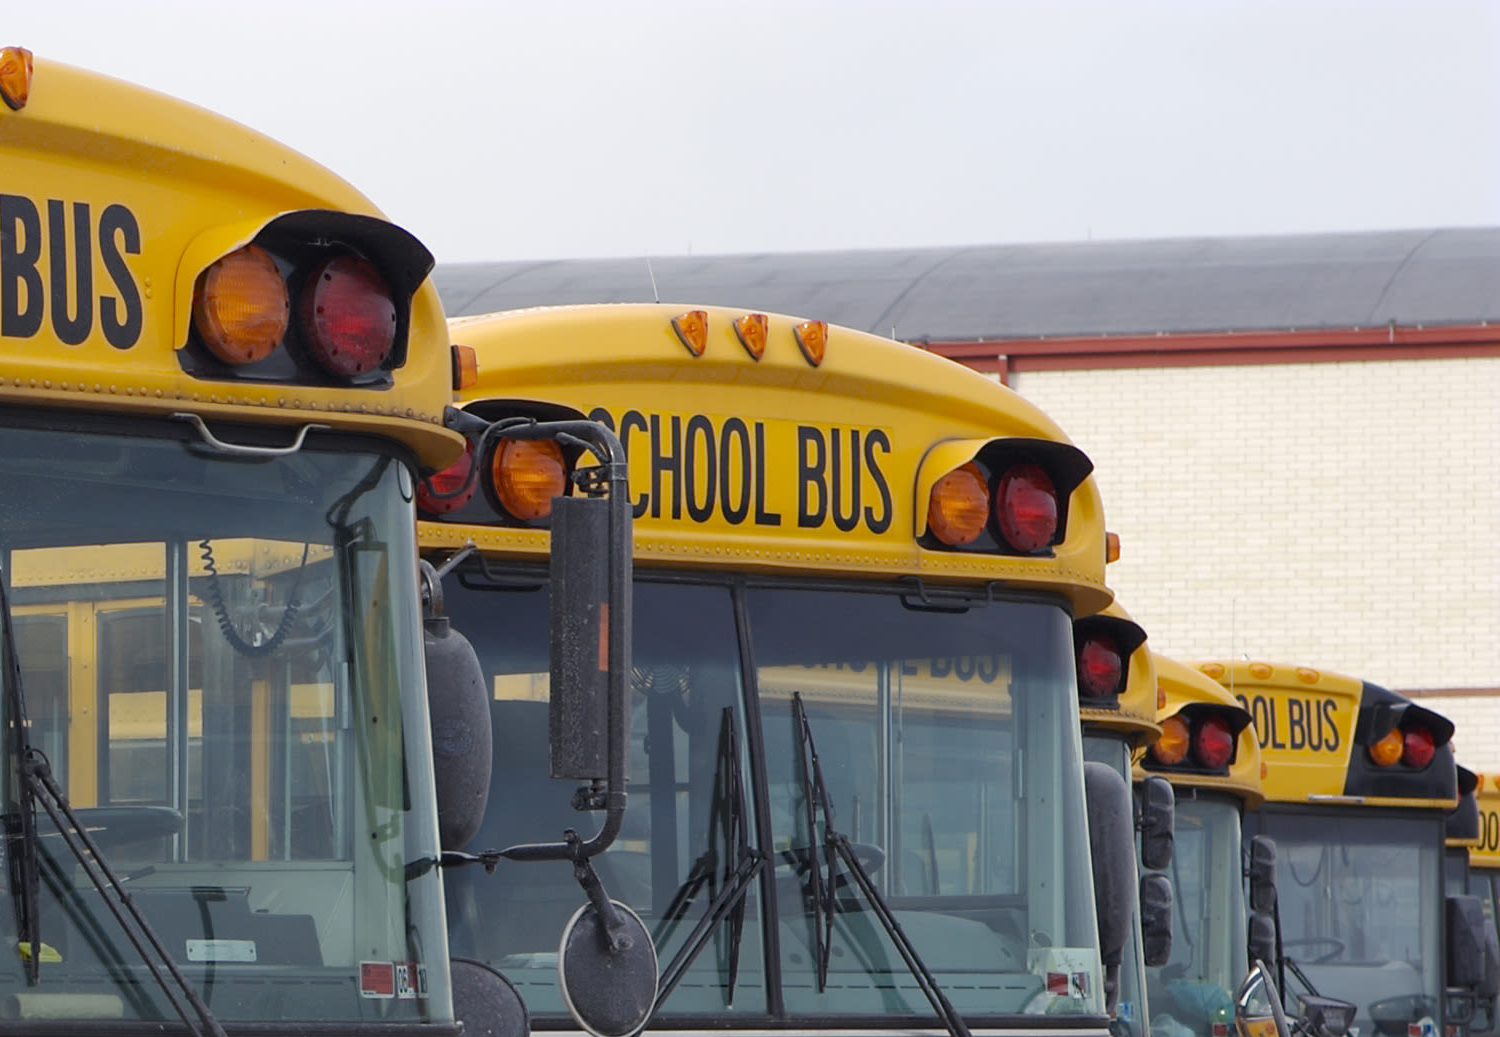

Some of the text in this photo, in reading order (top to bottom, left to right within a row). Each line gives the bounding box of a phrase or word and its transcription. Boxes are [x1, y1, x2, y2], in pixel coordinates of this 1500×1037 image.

[587, 407, 893, 534] CHOOL BUS
[1287, 697, 1340, 752] BUS
